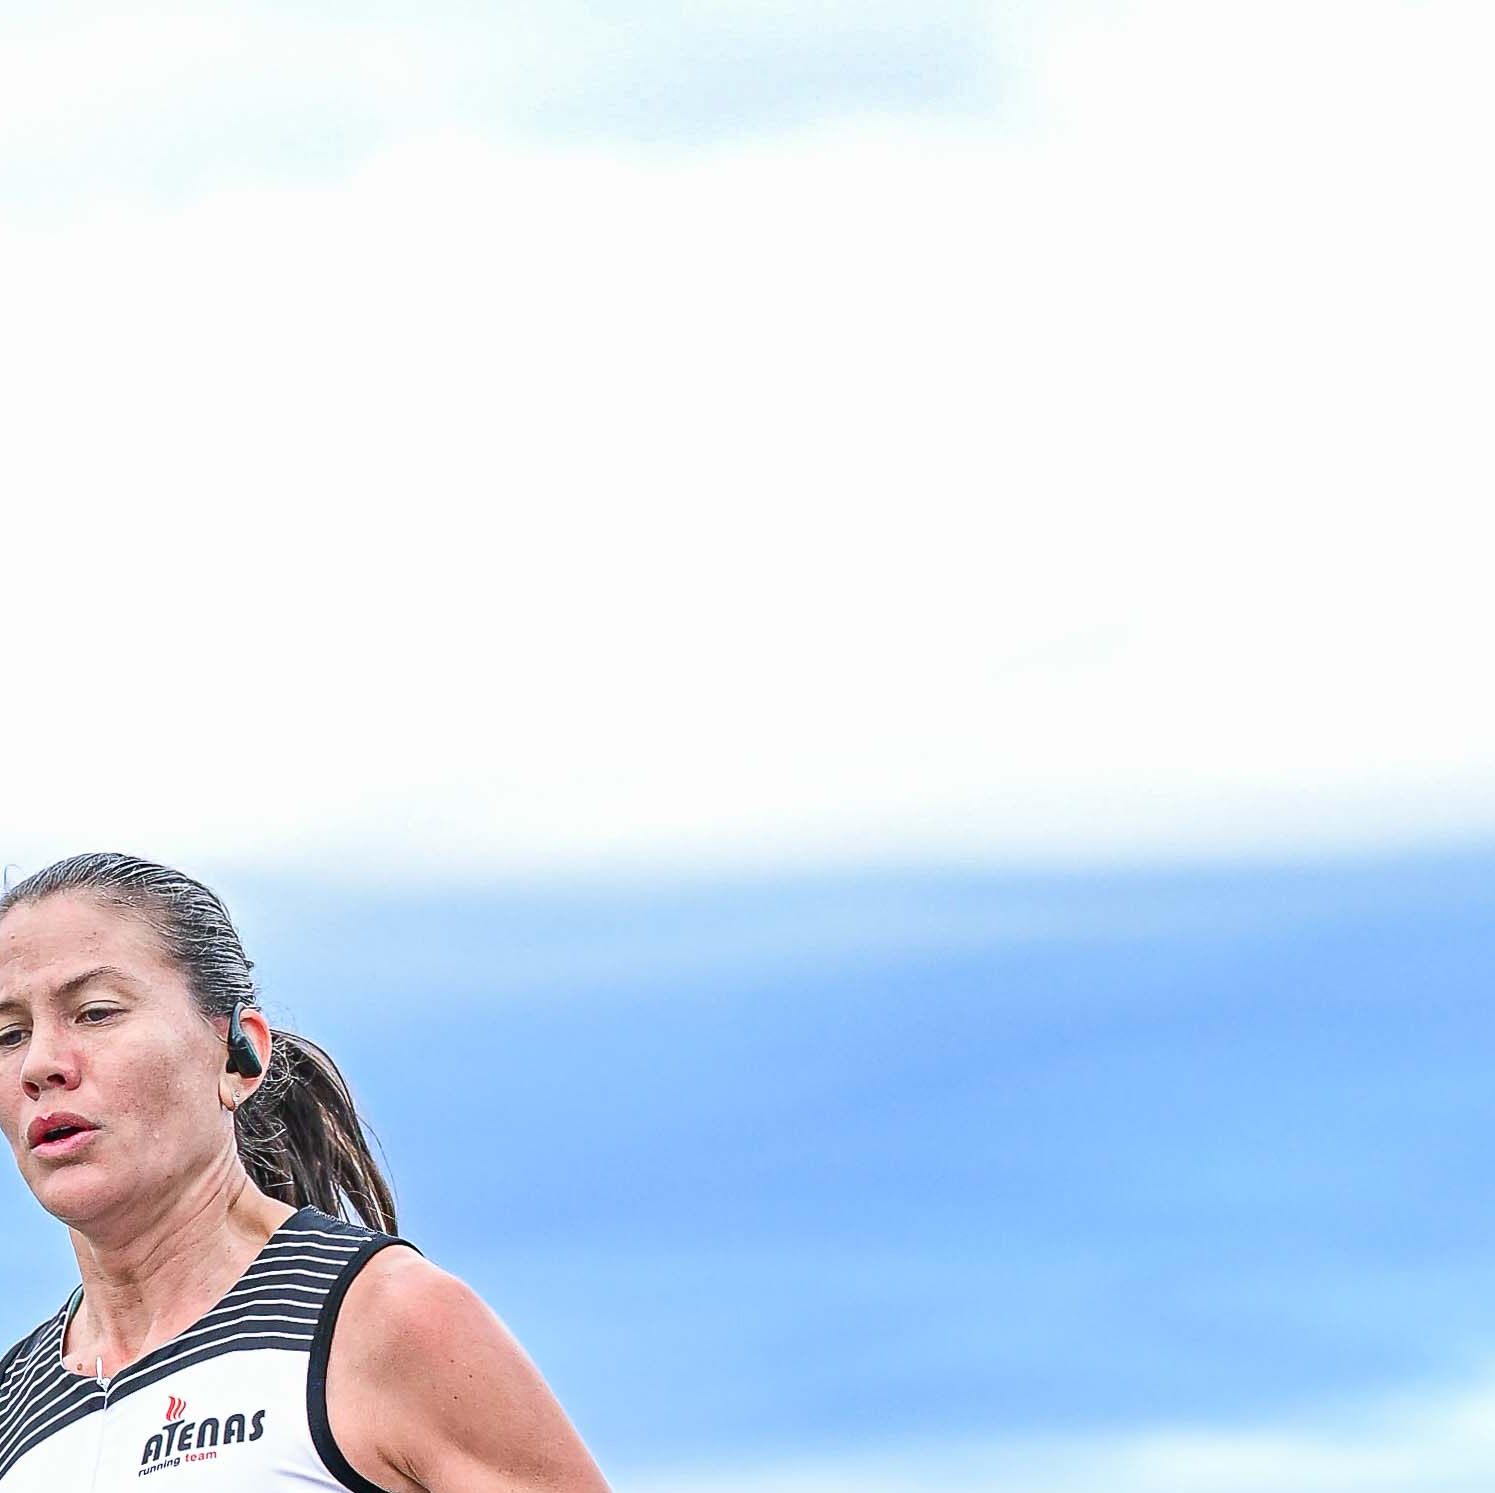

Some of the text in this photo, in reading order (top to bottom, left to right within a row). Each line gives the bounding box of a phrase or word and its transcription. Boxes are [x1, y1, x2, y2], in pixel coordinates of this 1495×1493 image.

[141, 1409, 266, 1466] ATENAS
[138, 1450, 218, 1478] running team
